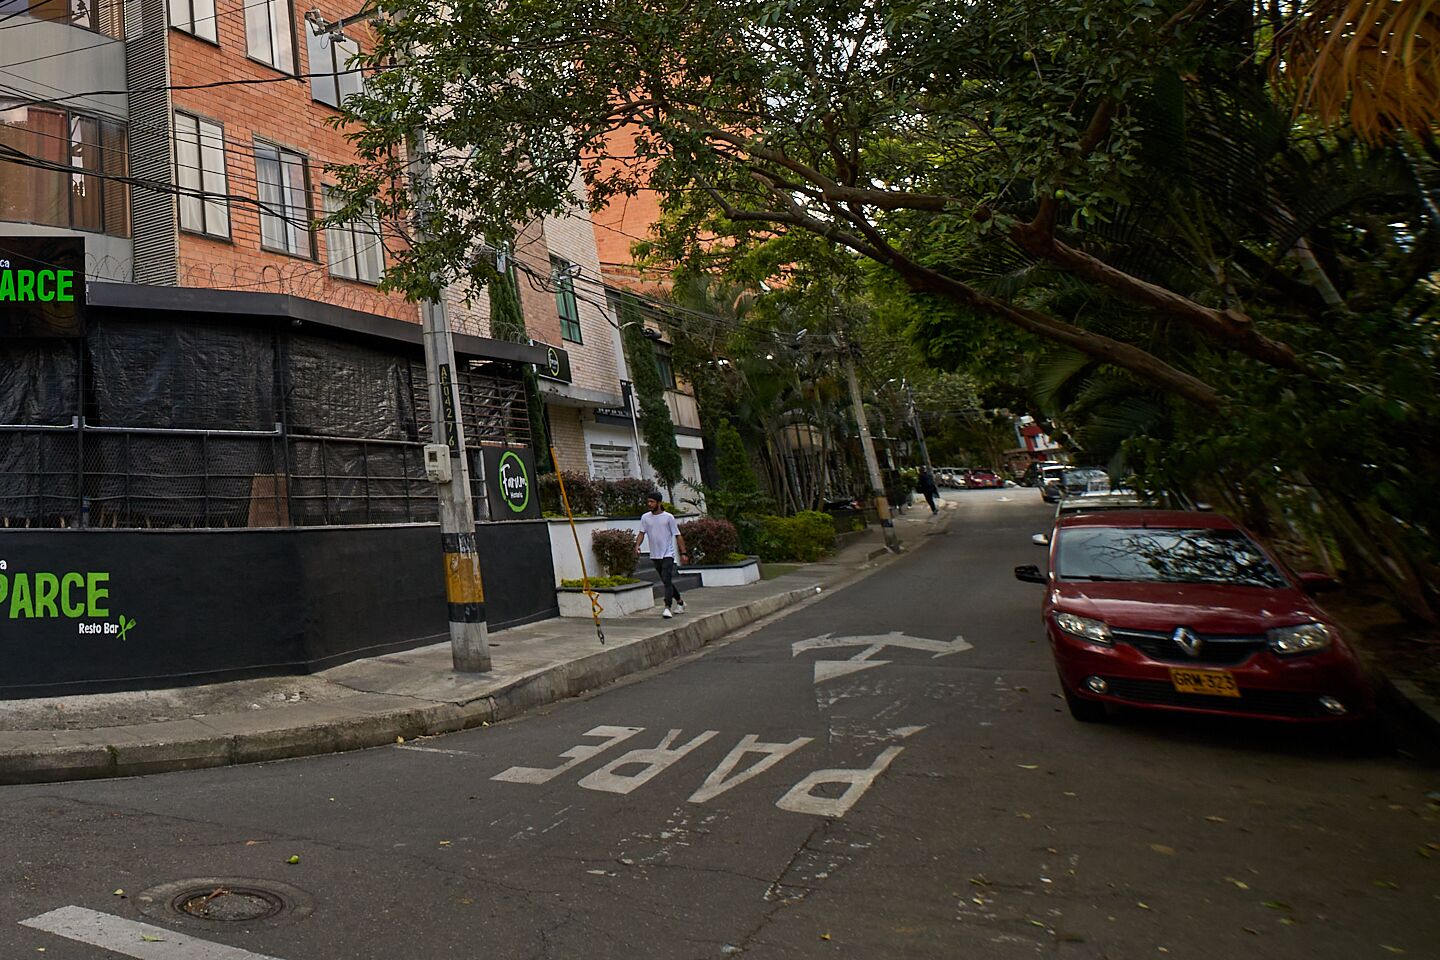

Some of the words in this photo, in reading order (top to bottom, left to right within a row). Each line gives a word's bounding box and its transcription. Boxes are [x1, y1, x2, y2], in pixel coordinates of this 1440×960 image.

[78, 622, 102, 634] Resto
[103, 622, 119, 634] Bar
[489, 725, 906, 818] PARE
